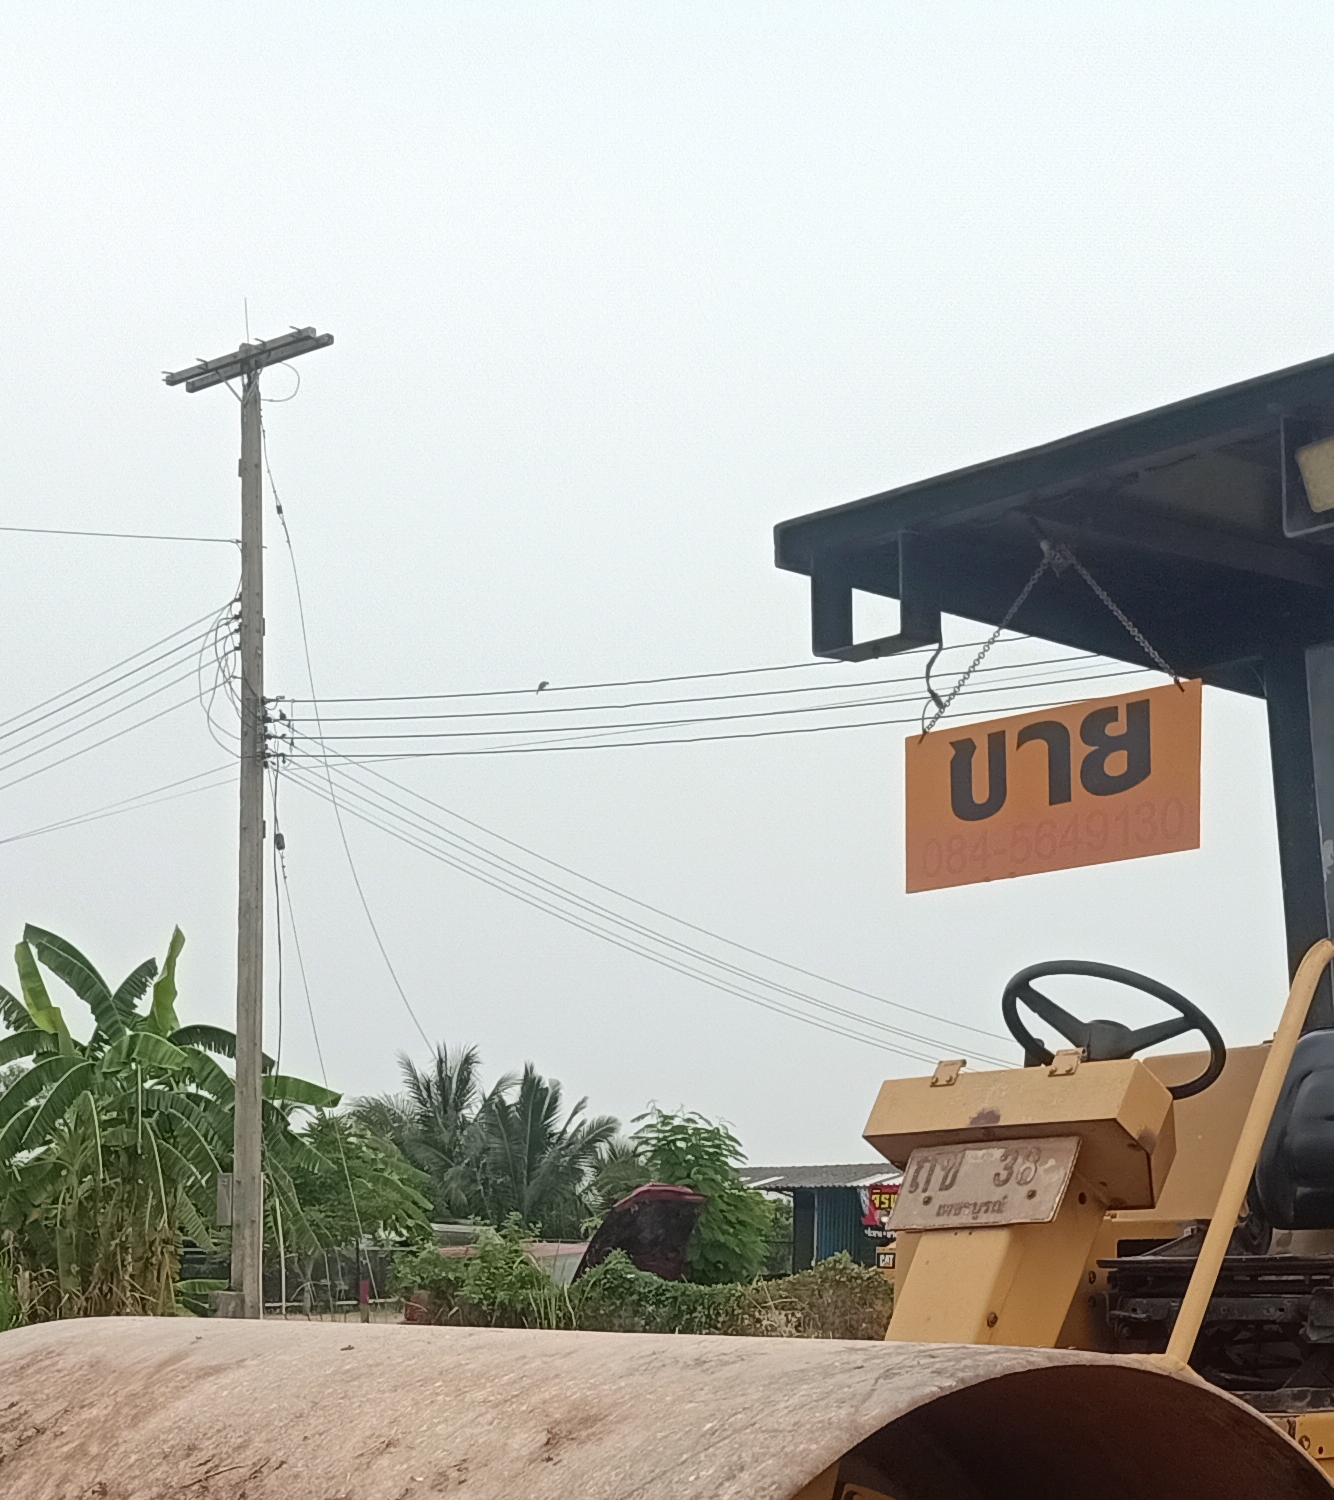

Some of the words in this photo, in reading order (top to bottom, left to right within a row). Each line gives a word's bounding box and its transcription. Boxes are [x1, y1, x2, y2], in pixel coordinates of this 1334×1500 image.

[949, 698, 1152, 822] ขาย
[922, 797, 1186, 878] 084-5649130
[879, 1254, 894, 1267] CAT
